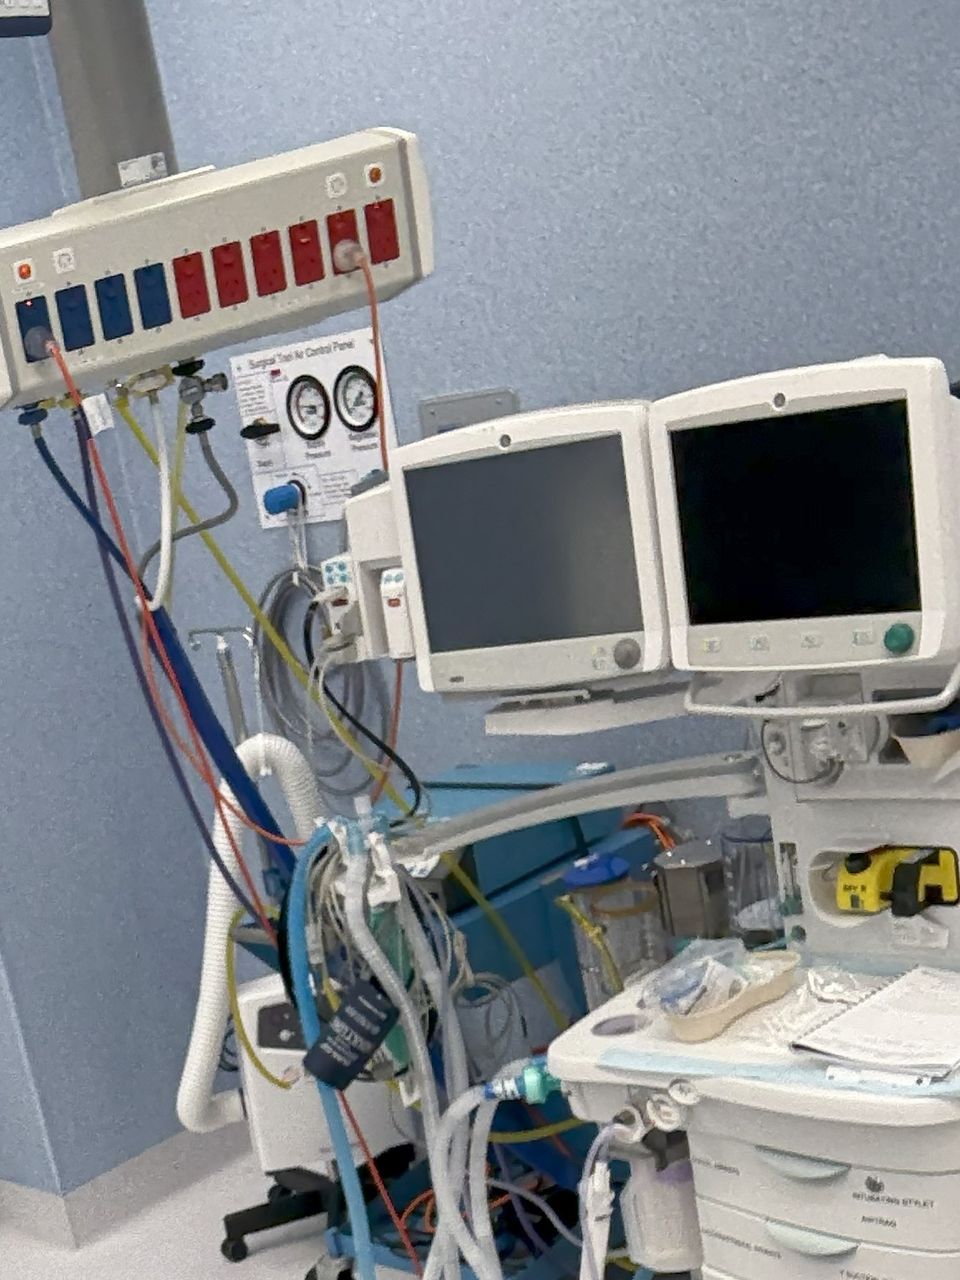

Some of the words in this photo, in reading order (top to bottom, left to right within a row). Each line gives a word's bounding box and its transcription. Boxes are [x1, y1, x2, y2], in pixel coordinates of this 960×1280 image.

[248, 356, 276, 370] Surgical
[306, 345, 331, 358] Control
[333, 340, 355, 352] Panel
